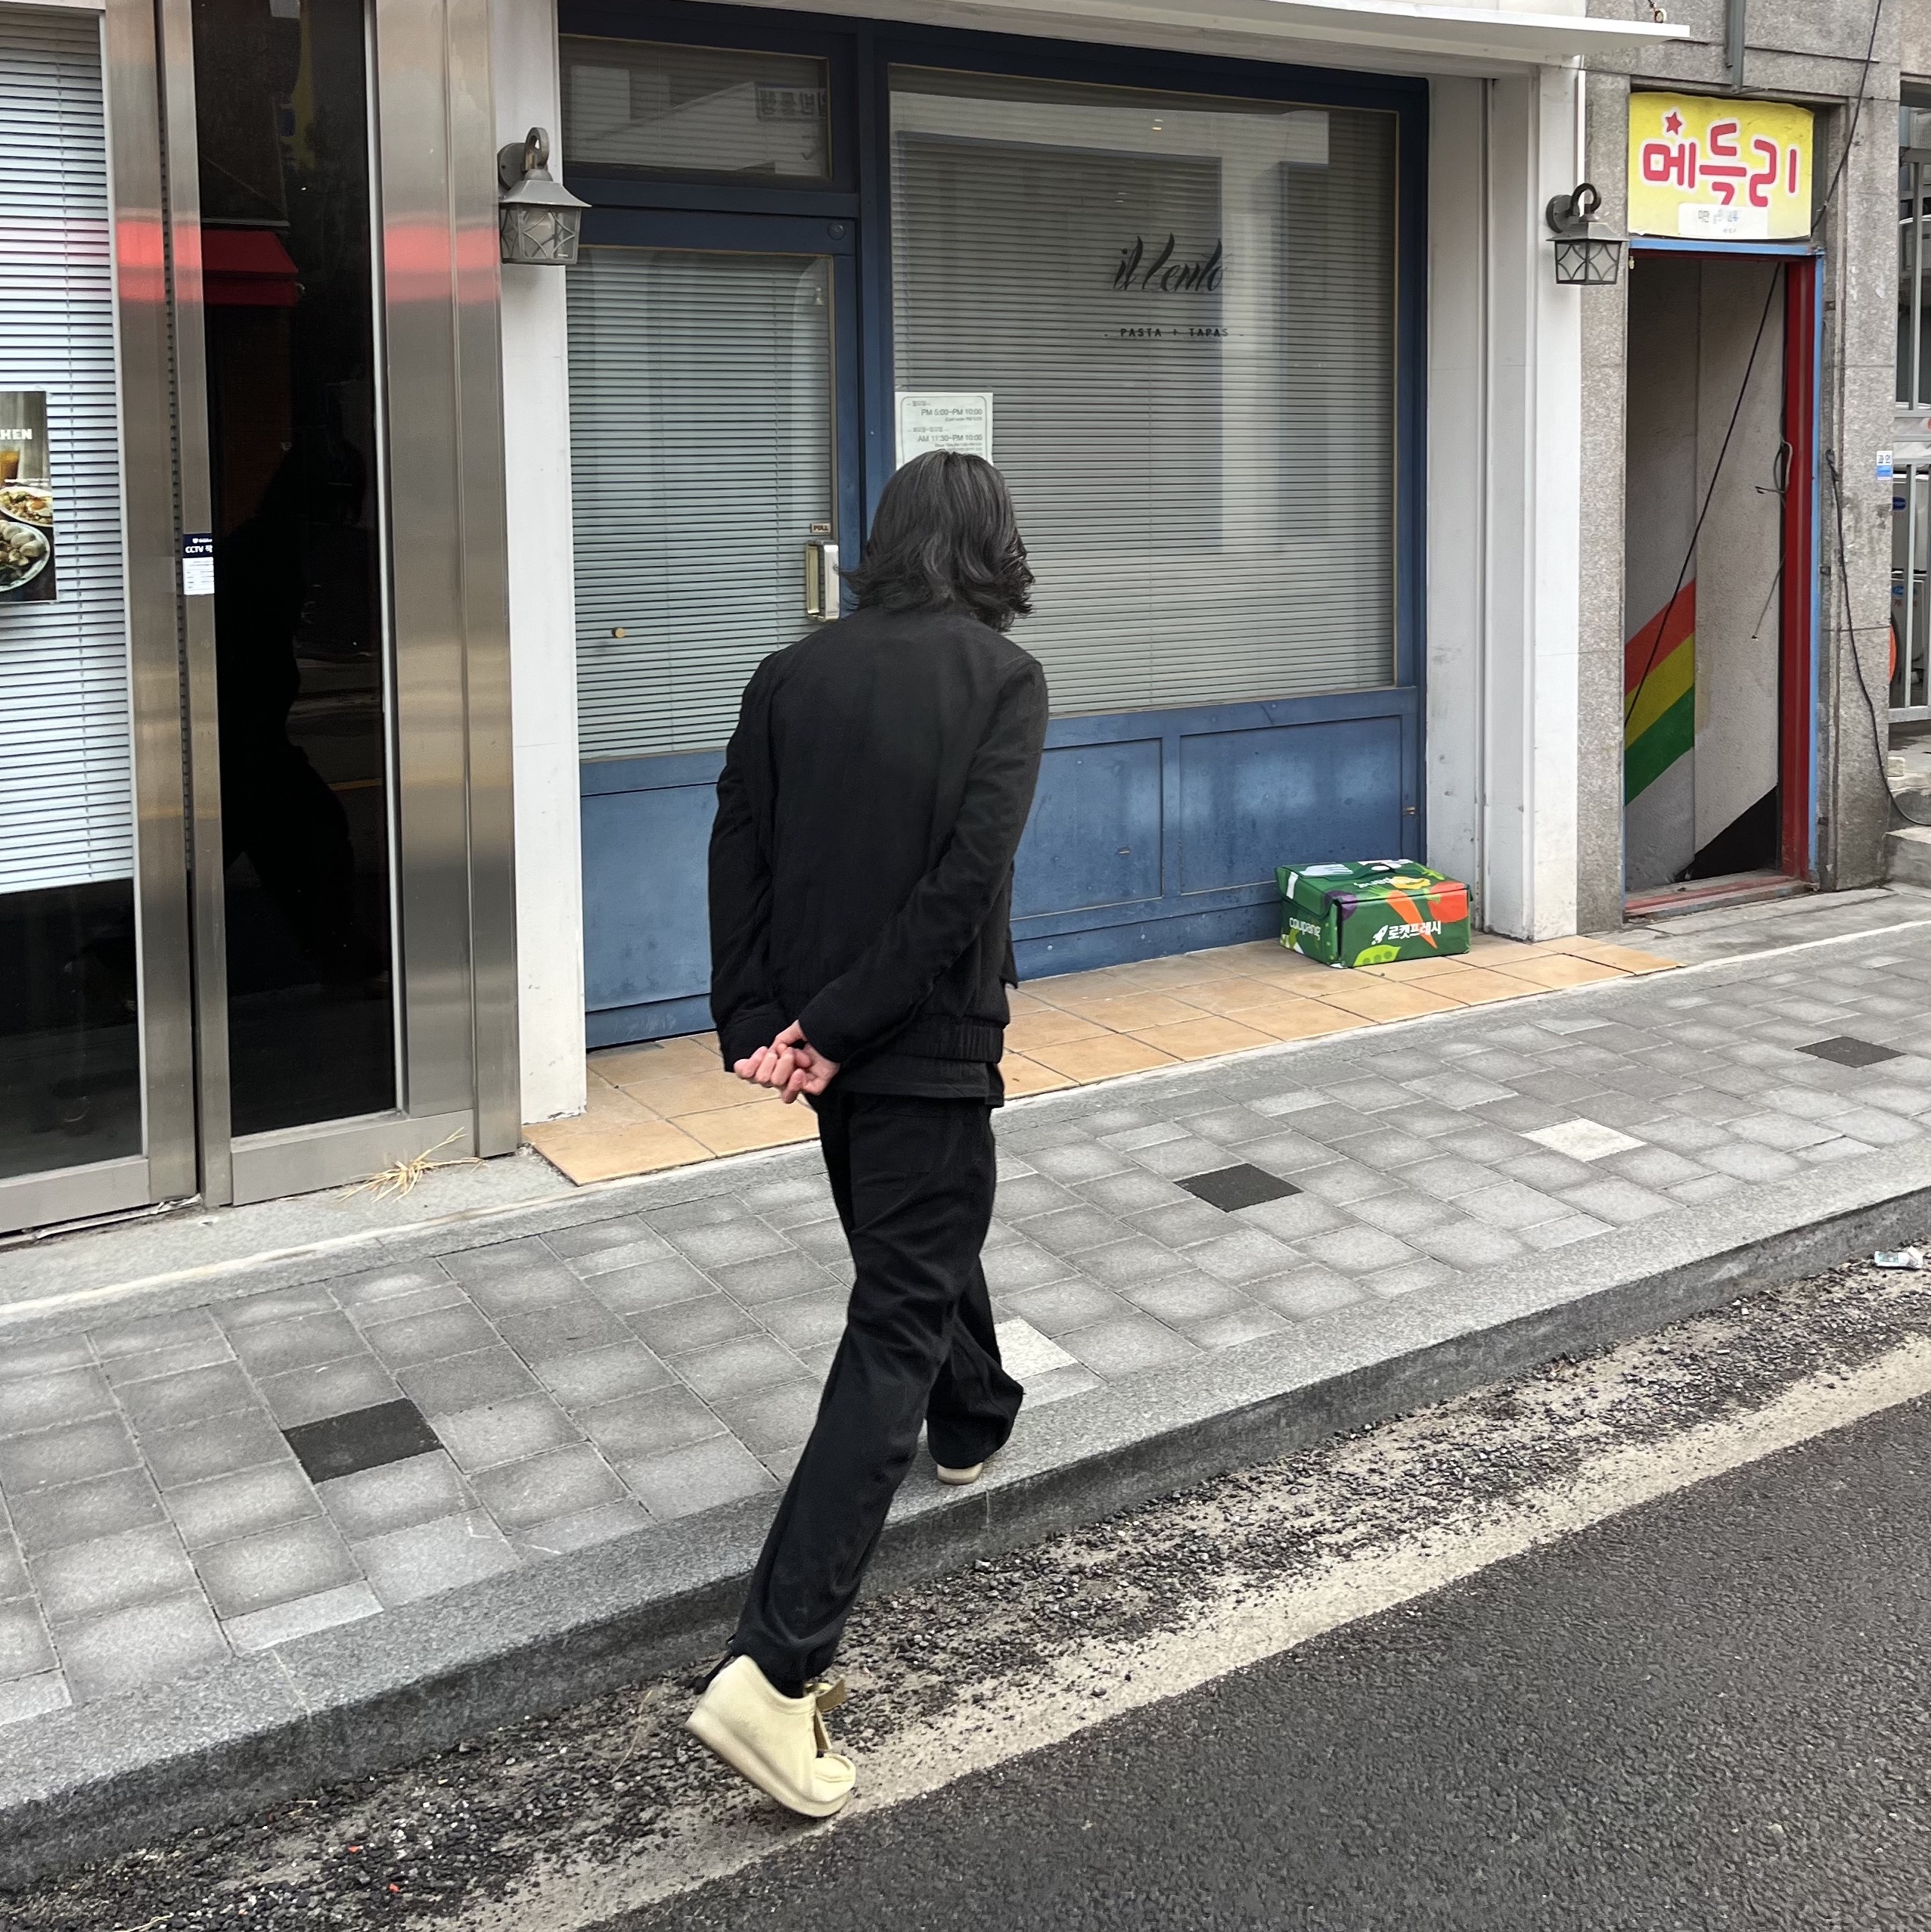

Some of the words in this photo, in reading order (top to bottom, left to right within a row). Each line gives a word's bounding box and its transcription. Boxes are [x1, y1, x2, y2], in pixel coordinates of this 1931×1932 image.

[1120, 328, 1162, 337] PASTA
[1189, 328, 1229, 337] TAPAS
[0, 428, 33, 440] HEN
[1289, 917, 1321, 940] coupang
[1387, 920, 1442, 940] 로켓프레시
